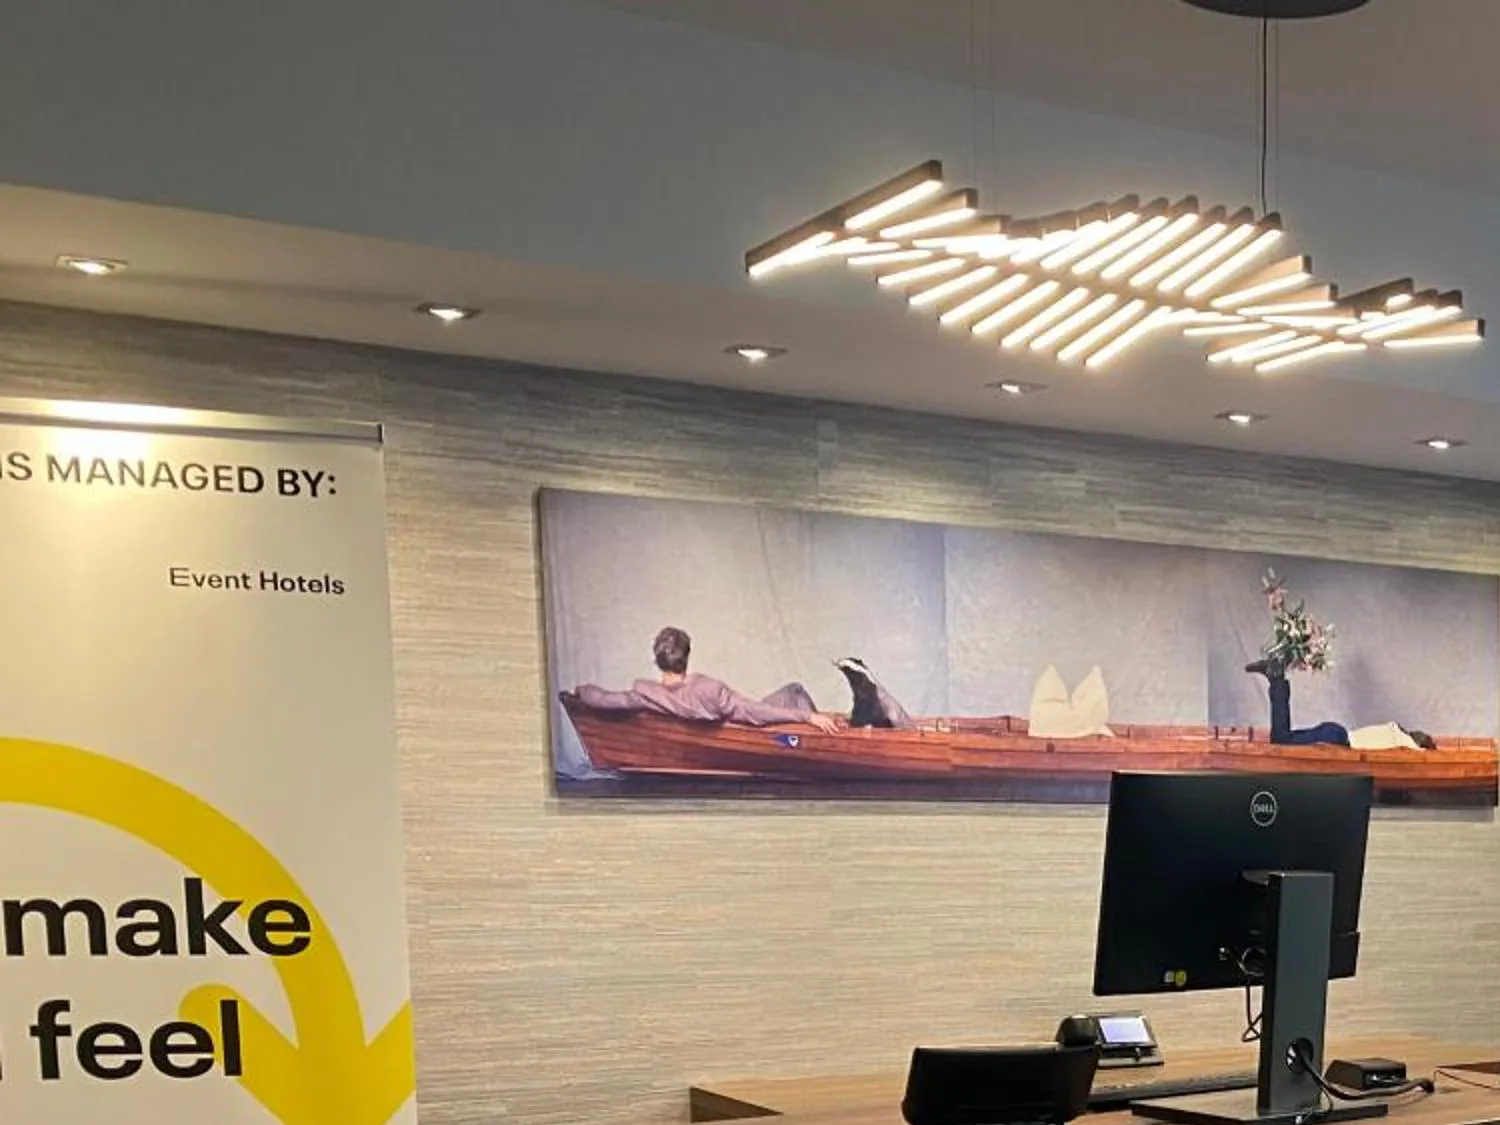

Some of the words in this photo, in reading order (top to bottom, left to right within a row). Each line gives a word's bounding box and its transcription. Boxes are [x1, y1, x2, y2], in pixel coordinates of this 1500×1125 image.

[46, 453, 264, 494] MANAGED
[277, 467, 337, 499] BY:
[169, 567, 252, 591] Event
[259, 570, 345, 595] Hotels
[3, 877, 311, 957] make
[30, 999, 242, 1080] feel
